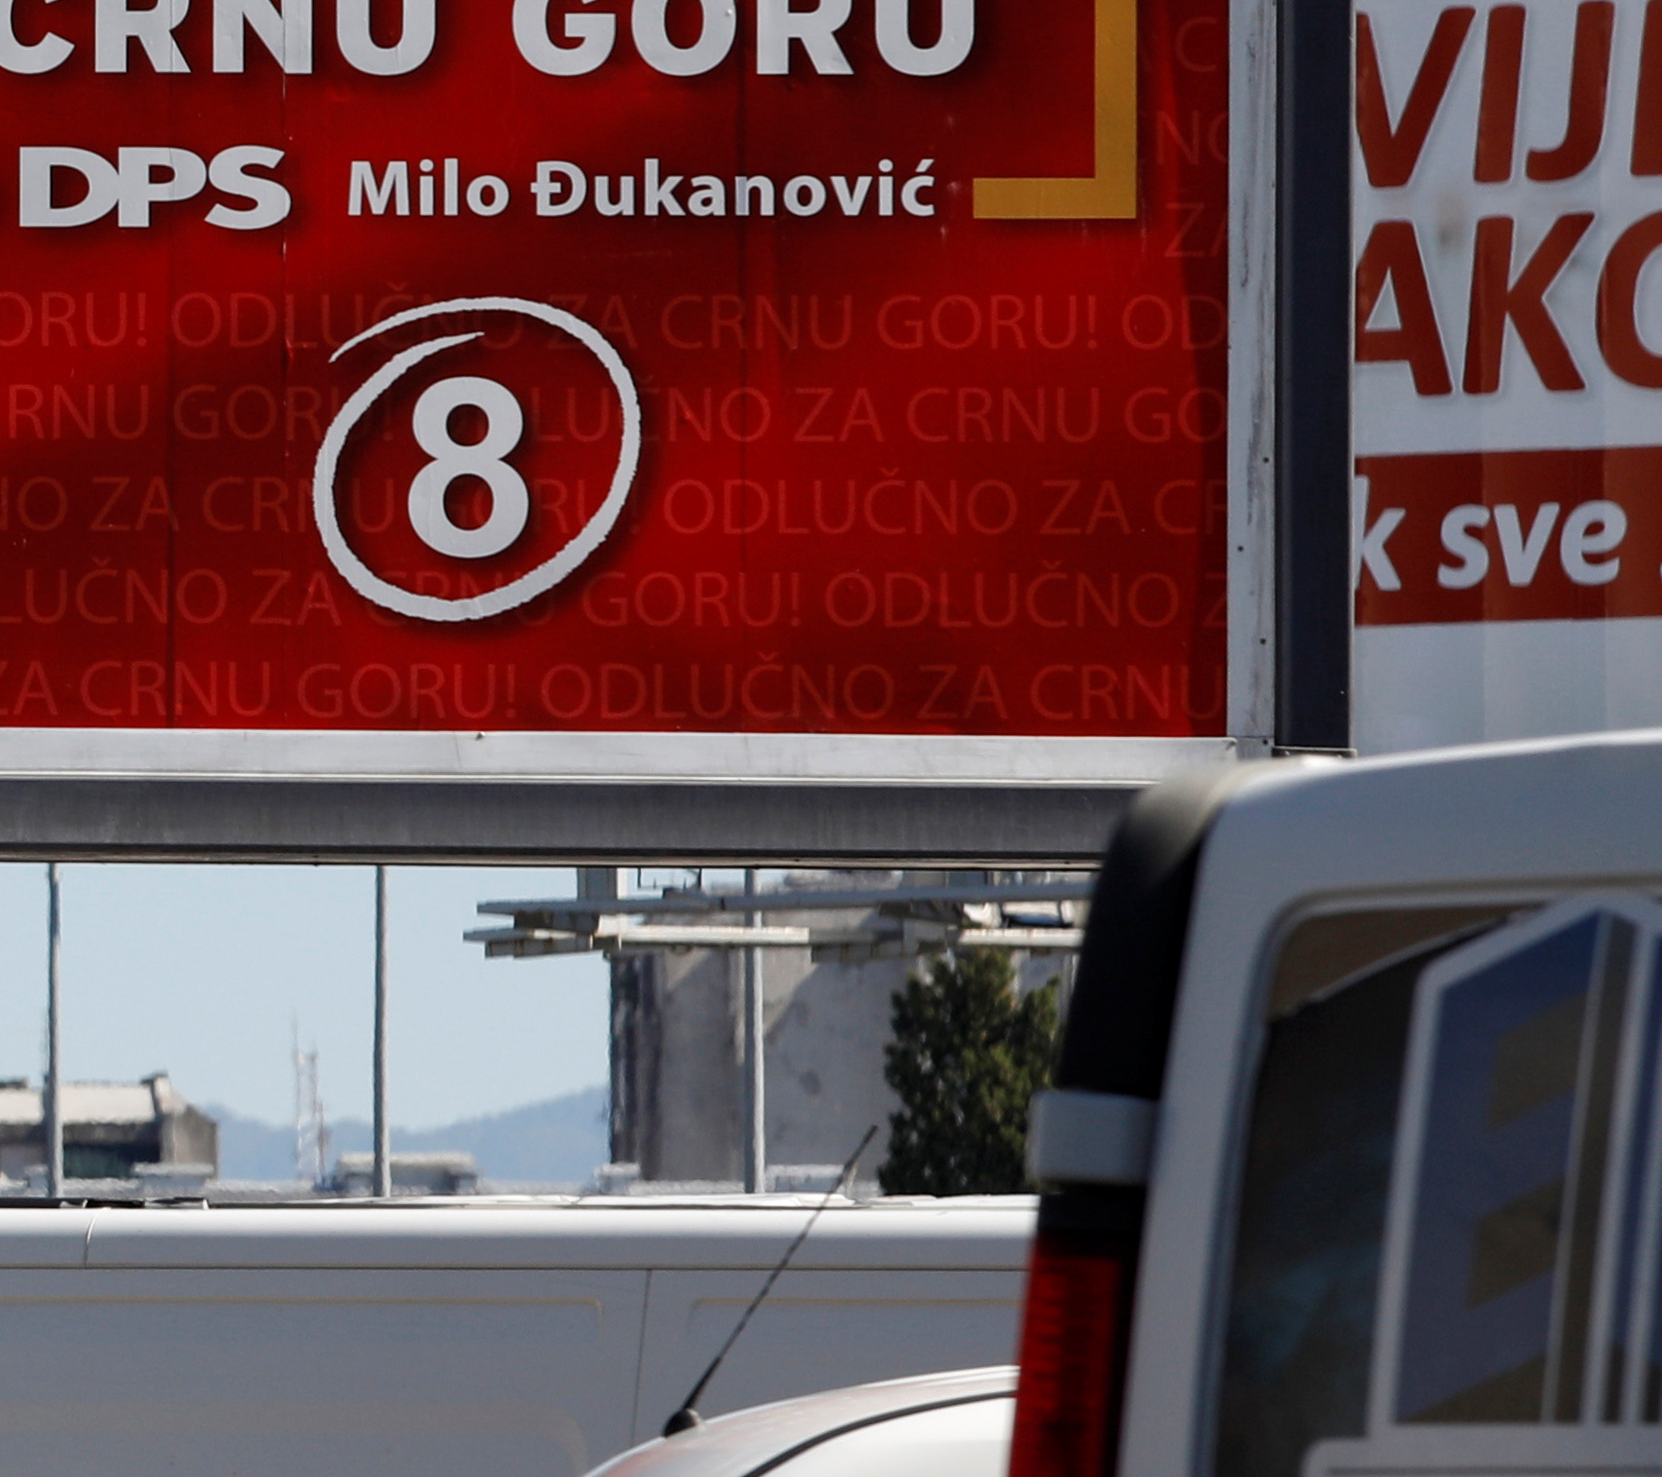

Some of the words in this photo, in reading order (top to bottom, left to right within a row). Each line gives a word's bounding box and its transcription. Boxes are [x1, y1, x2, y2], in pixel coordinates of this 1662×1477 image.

[19, 145, 291, 230] DPS
[347, 157, 509, 217] Milo
[530, 158, 935, 217] Đukanović
[407, 378, 526, 559] 8
[1437, 501, 1627, 588] sve
